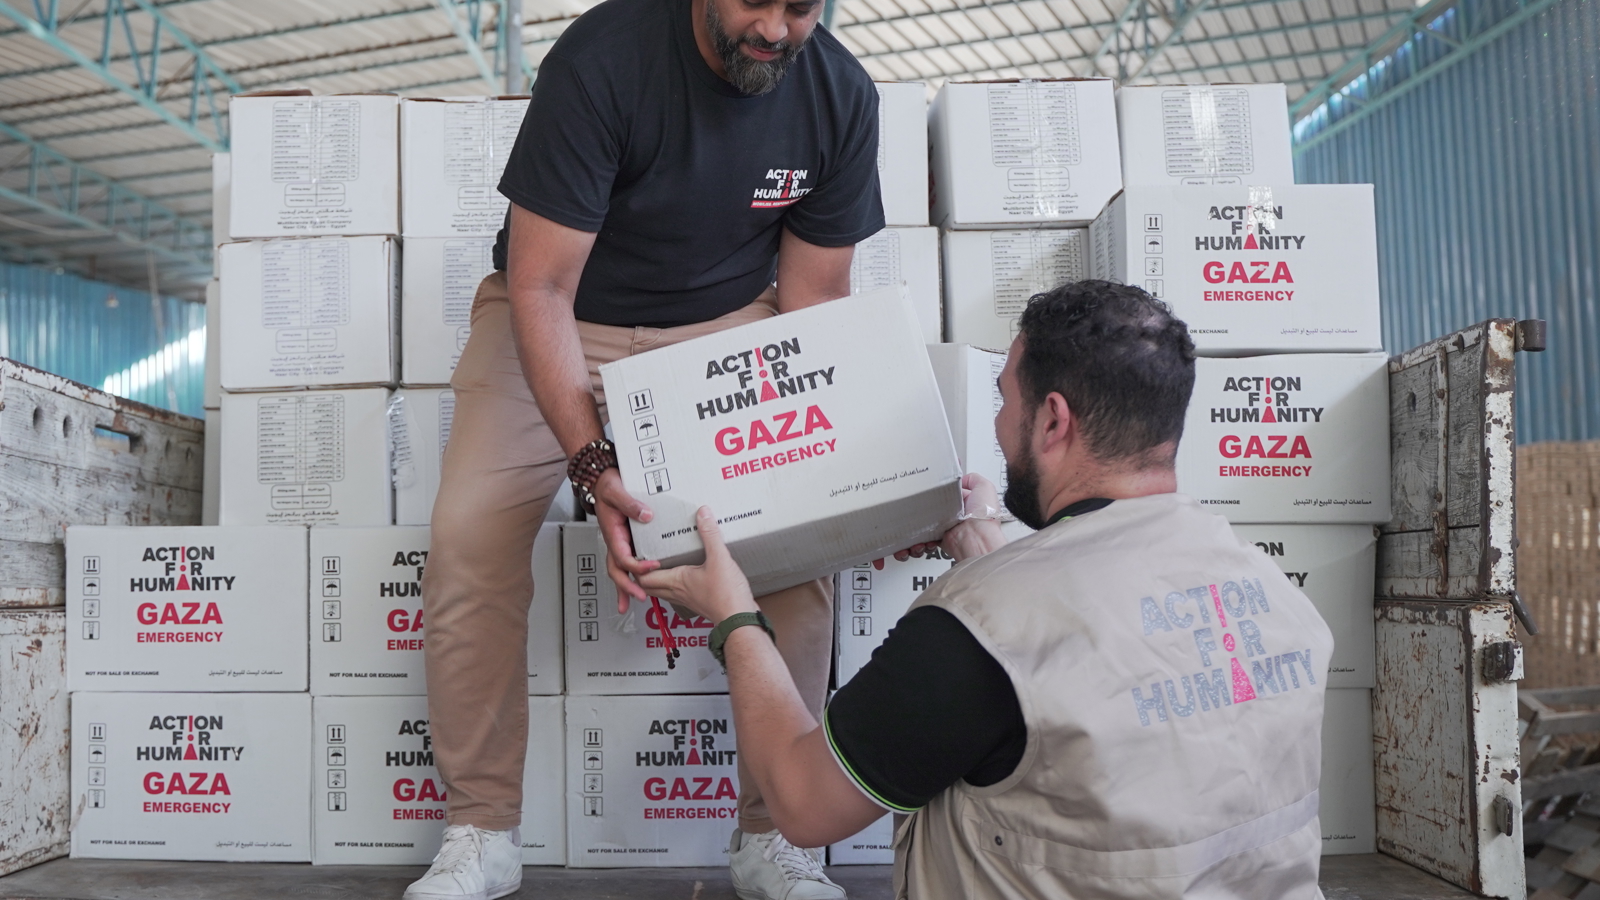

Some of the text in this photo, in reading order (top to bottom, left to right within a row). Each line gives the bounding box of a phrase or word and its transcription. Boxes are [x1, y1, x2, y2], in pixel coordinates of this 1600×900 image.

[765, 168, 808, 182] ACTION
[753, 188, 814, 199] HUMANITY
[1194, 234, 1306, 250] HUMANITY
[1202, 261, 1294, 284] GAZA
[1203, 290, 1294, 302] EMERGENCY
[706, 337, 801, 380] ACTION
[738, 361, 789, 390] FOR
[696, 367, 836, 420] HUMANITY
[1223, 376, 1301, 394] ACTION
[1248, 392, 1289, 406] FOR
[1210, 406, 1324, 423] HUMANITY
[714, 404, 833, 456] GAZA
[1218, 435, 1312, 458] GAZA
[721, 438, 837, 480] EMERGENCY
[880, 473, 898, 483] ليست
[900, 466, 929, 478] مساعدات
[1219, 466, 1312, 476] EMERGENCY
[829, 485, 853, 498] التبديل
[862, 478, 878, 490] للبيع
[1318, 499, 1332, 507] للبيع
[661, 531, 676, 539] NOT
[724, 509, 763, 523] EXCHANGE
[142, 546, 215, 562] ACTION
[392, 550, 429, 566] ACT
[165, 562, 202, 576] FOR
[130, 574, 235, 592] HUMANITY
[137, 602, 223, 625] GAZA
[1140, 577, 1270, 636] ACTION
[387, 609, 425, 632] GA
[137, 632, 223, 643] EMERGENCY
[1193, 619, 1266, 667] FOR
[1131, 649, 1316, 727] HUMANITY
[149, 715, 223, 732] ACTION
[648, 719, 727, 736] ACTION
[172, 731, 210, 745] FOR
[674, 735, 714, 750] FOR
[136, 744, 244, 761] HUMANITY
[636, 748, 736, 766] HUMANIT
[143, 772, 231, 795] GAZA
[393, 778, 447, 802] GA
[644, 777, 737, 801] GAZA
[143, 802, 231, 813] EMERGENCY
[393, 809, 447, 820] EMERG
[644, 807, 737, 819] EMERGENCY
